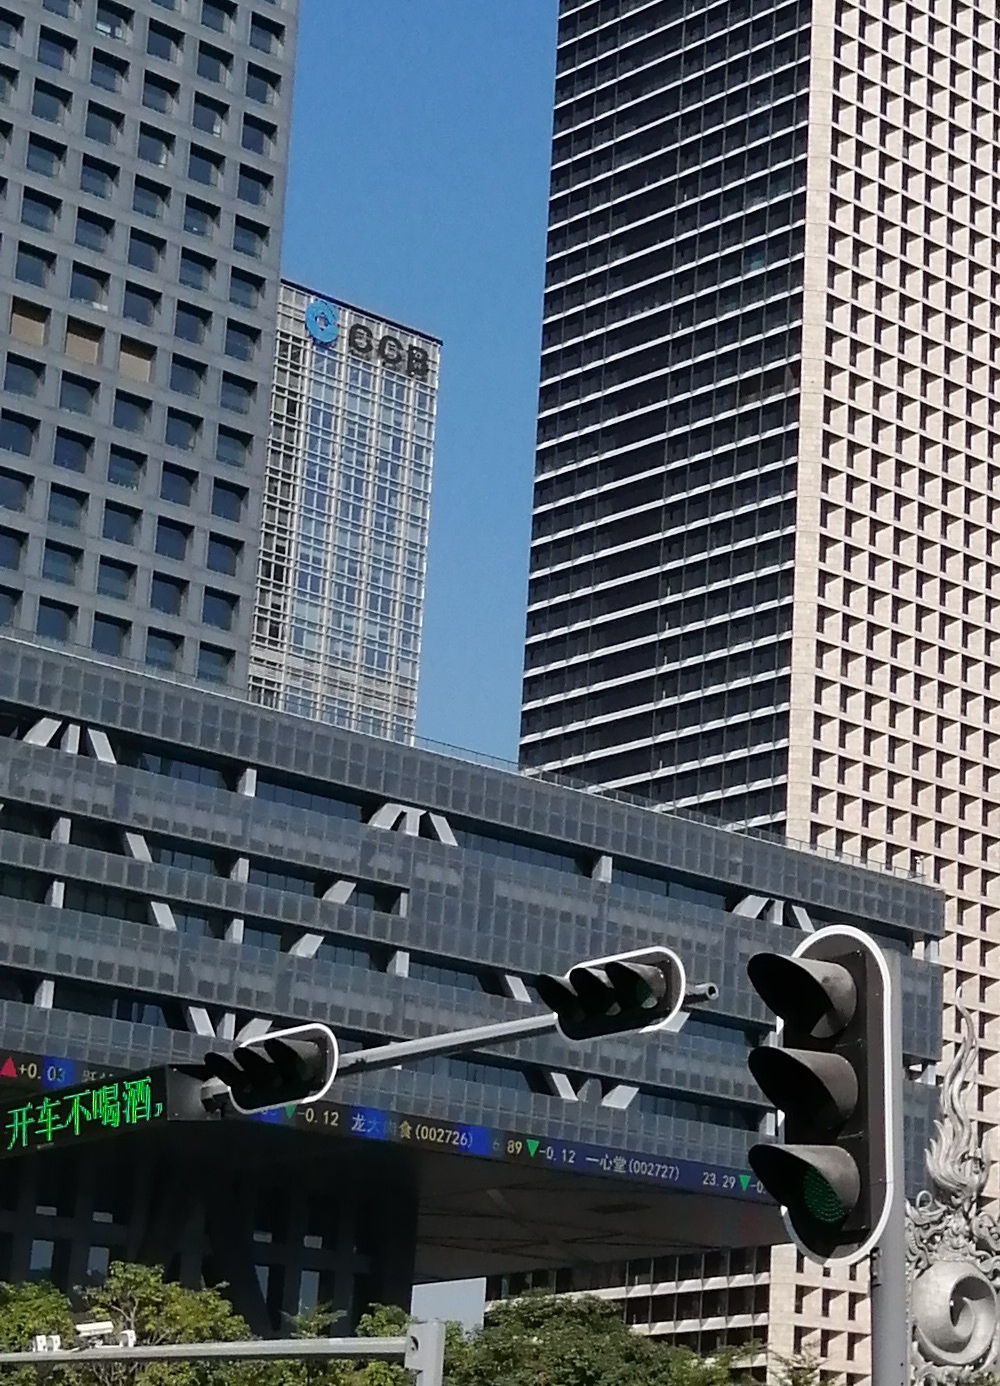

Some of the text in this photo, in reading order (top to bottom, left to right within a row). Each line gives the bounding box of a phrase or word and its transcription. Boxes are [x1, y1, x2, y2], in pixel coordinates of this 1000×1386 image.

[297, 1107, 340, 1128] -0.12
[538, 1145, 576, 1164] -0.12
[585, 1151, 681, 1181] 一心堂(002727)
[703, 1171, 737, 1190] 23.29
